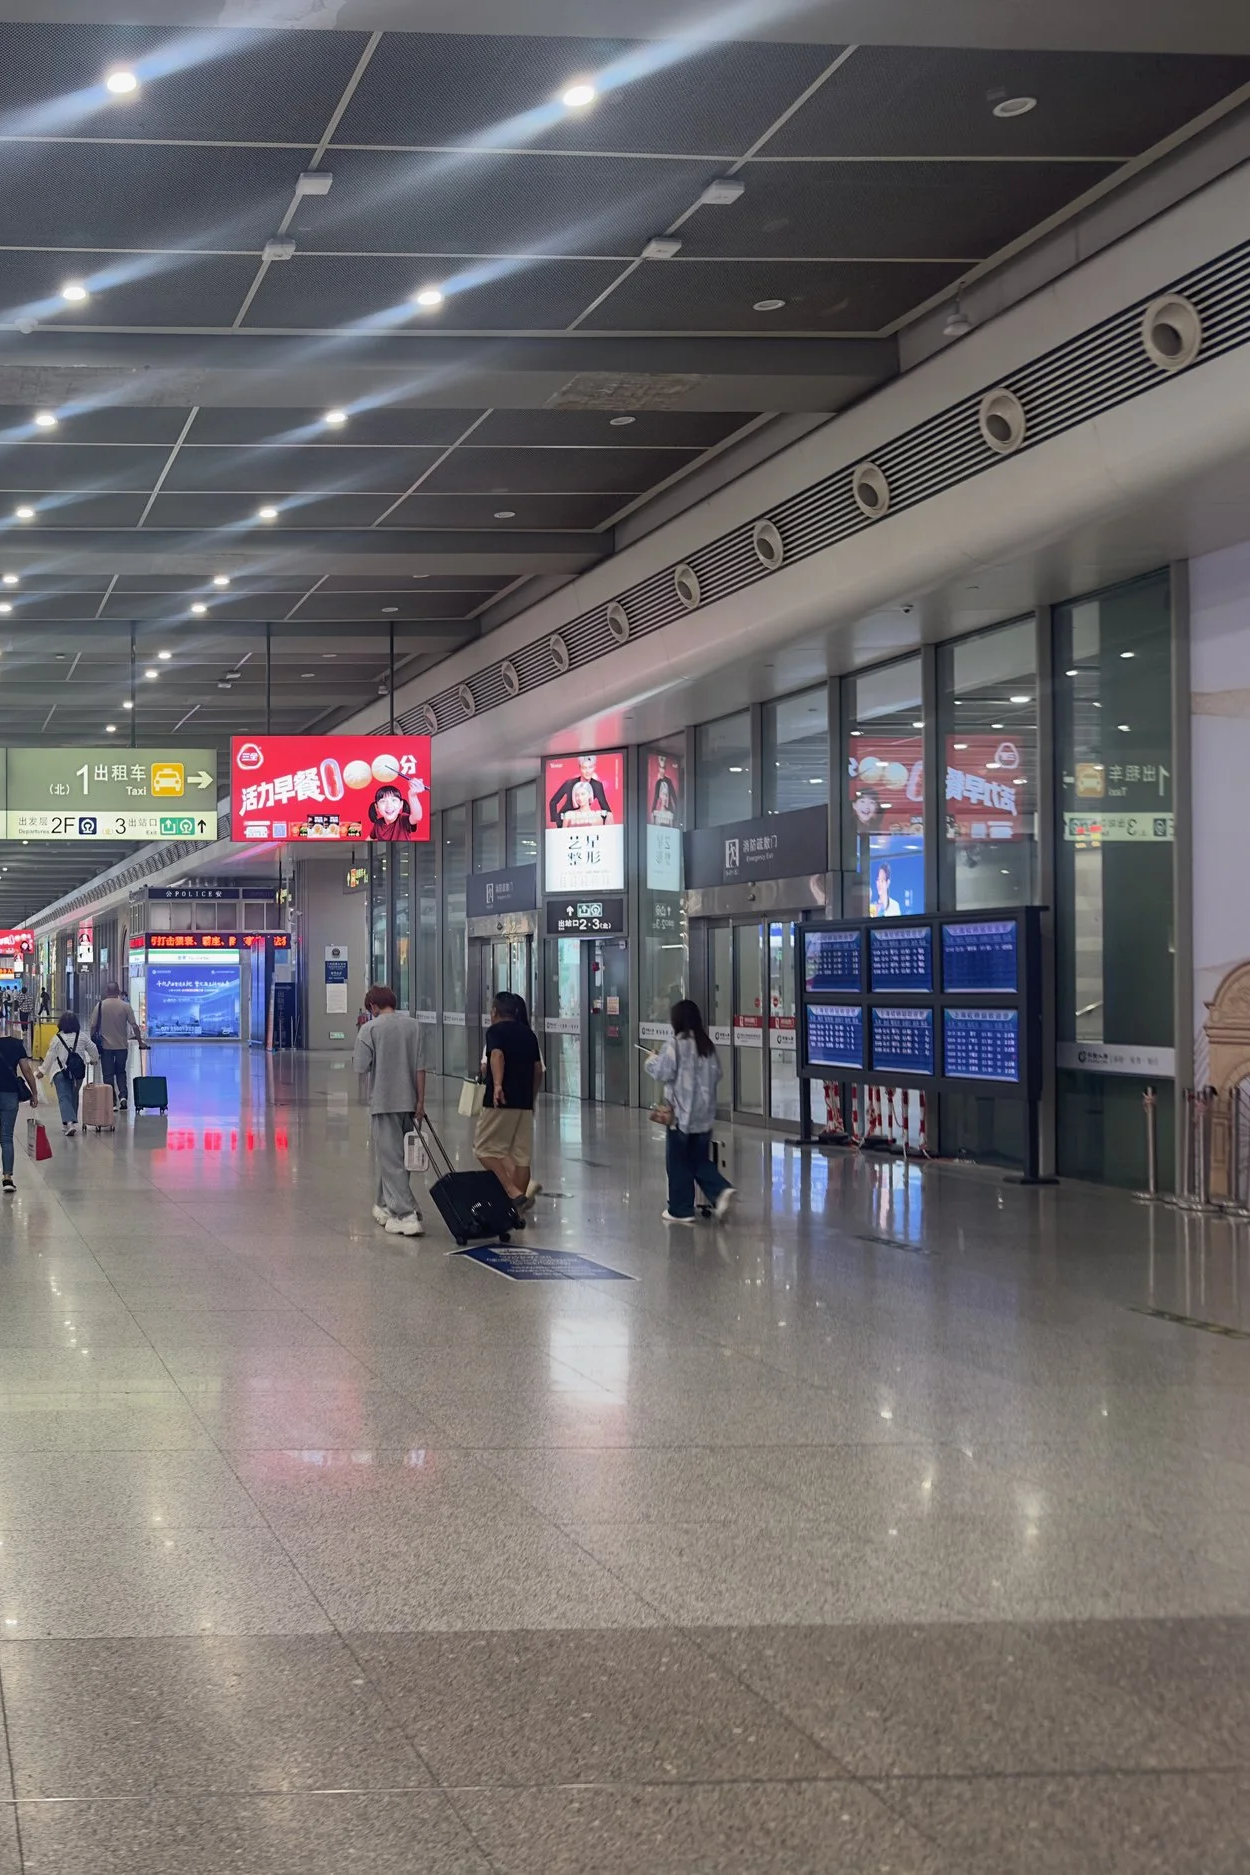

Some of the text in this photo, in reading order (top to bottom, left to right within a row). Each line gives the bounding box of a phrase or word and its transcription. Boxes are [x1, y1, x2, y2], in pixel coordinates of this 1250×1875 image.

[76, 764, 89, 795] 1
[94, 764, 146, 782] 出租车
[126, 786, 147, 796] Taxi
[18, 817, 48, 826] 出发层
[51, 817, 75, 834] 2F
[115, 818, 126, 835] 3
[128, 818, 158, 827] 出站口
